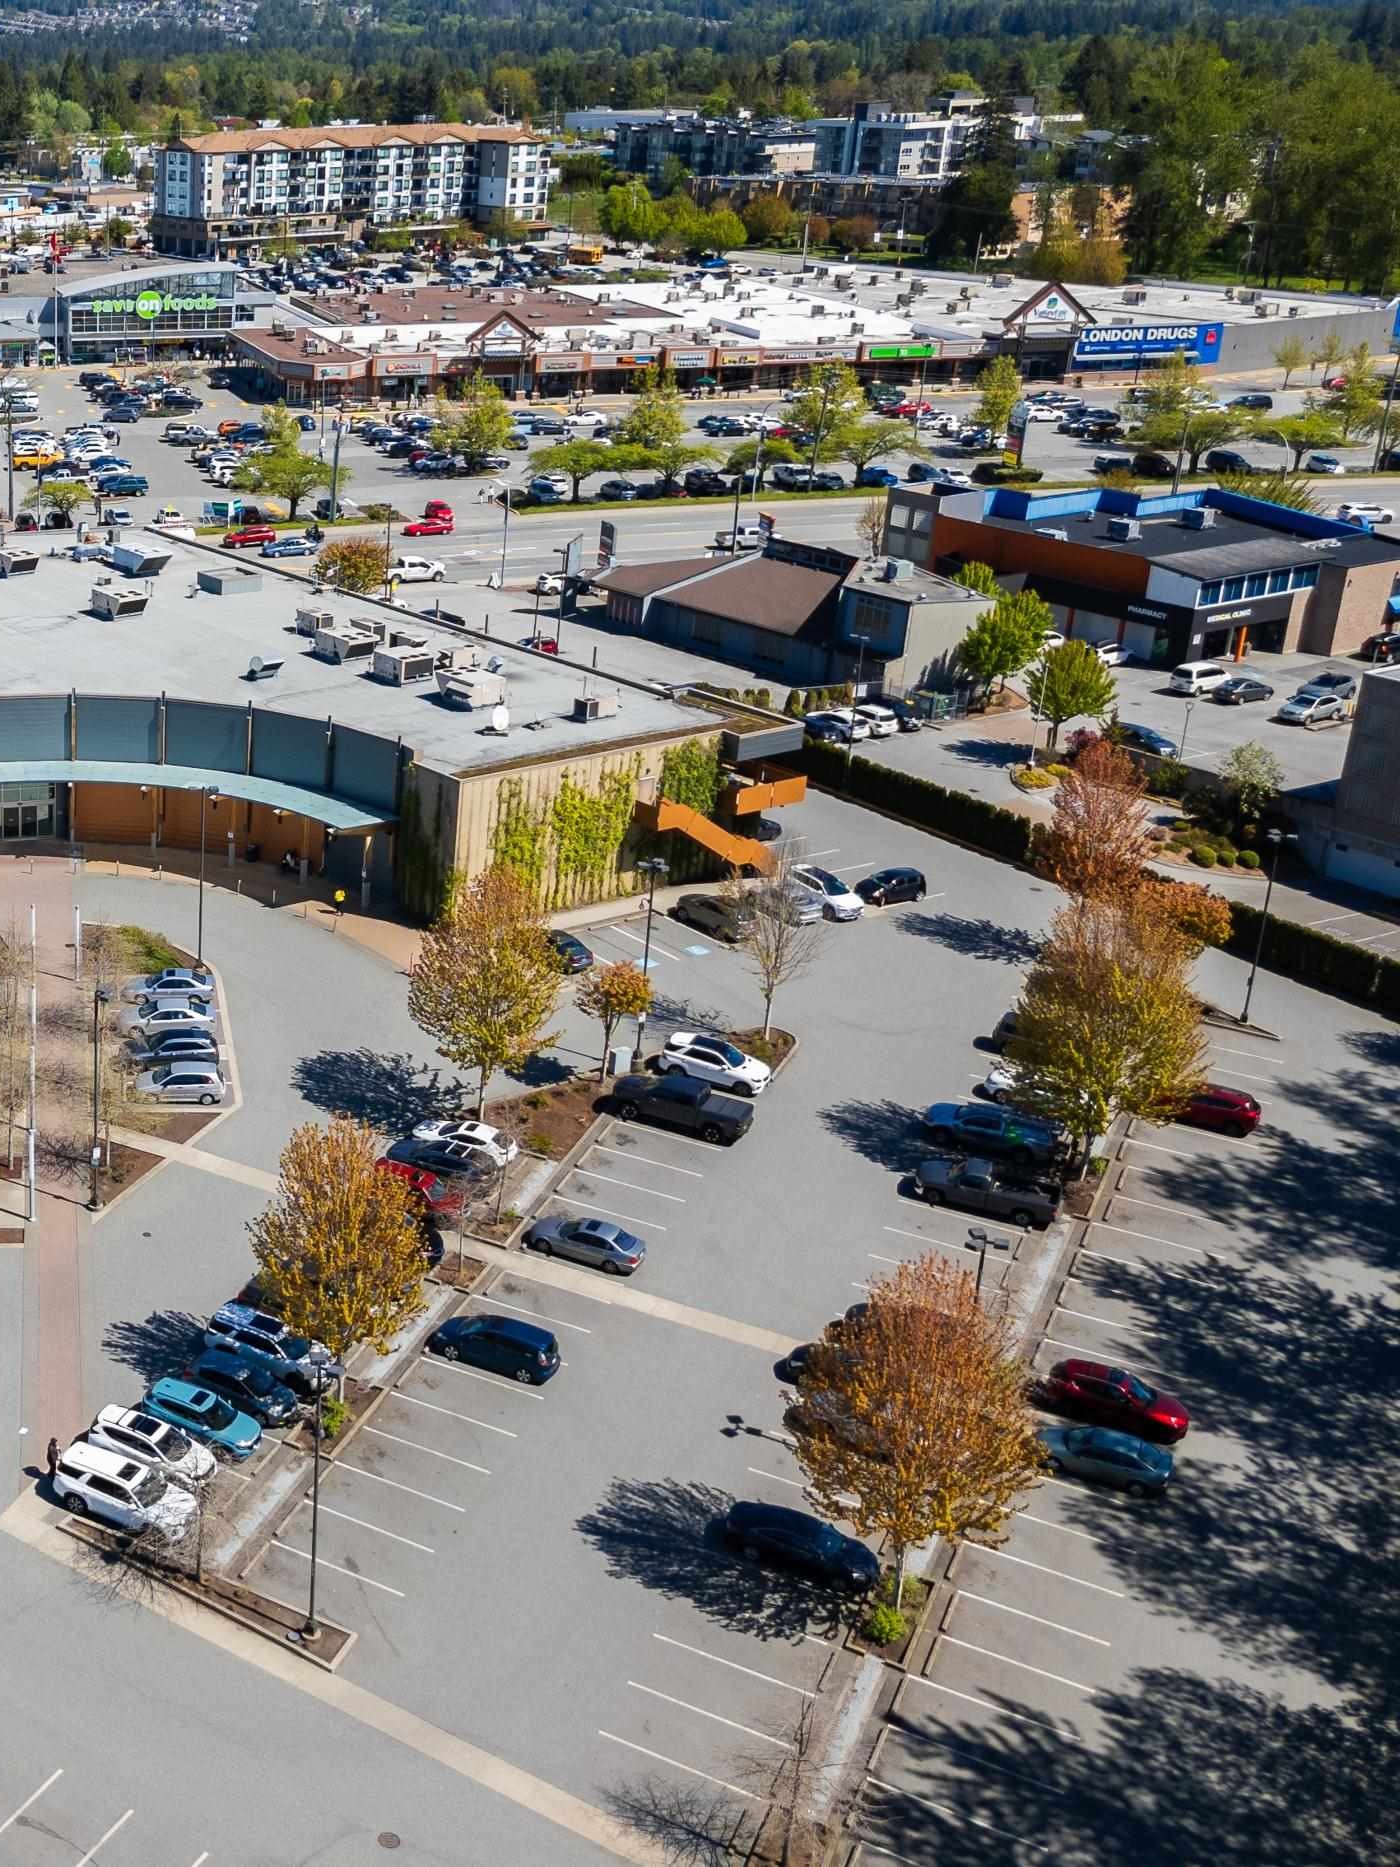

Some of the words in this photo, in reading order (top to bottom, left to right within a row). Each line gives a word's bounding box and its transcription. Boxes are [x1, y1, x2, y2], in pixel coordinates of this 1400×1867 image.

[164, 294, 217, 311] foods
[1081, 329, 1141, 342] LONDON
[1146, 327, 1198, 340] DRUGS
